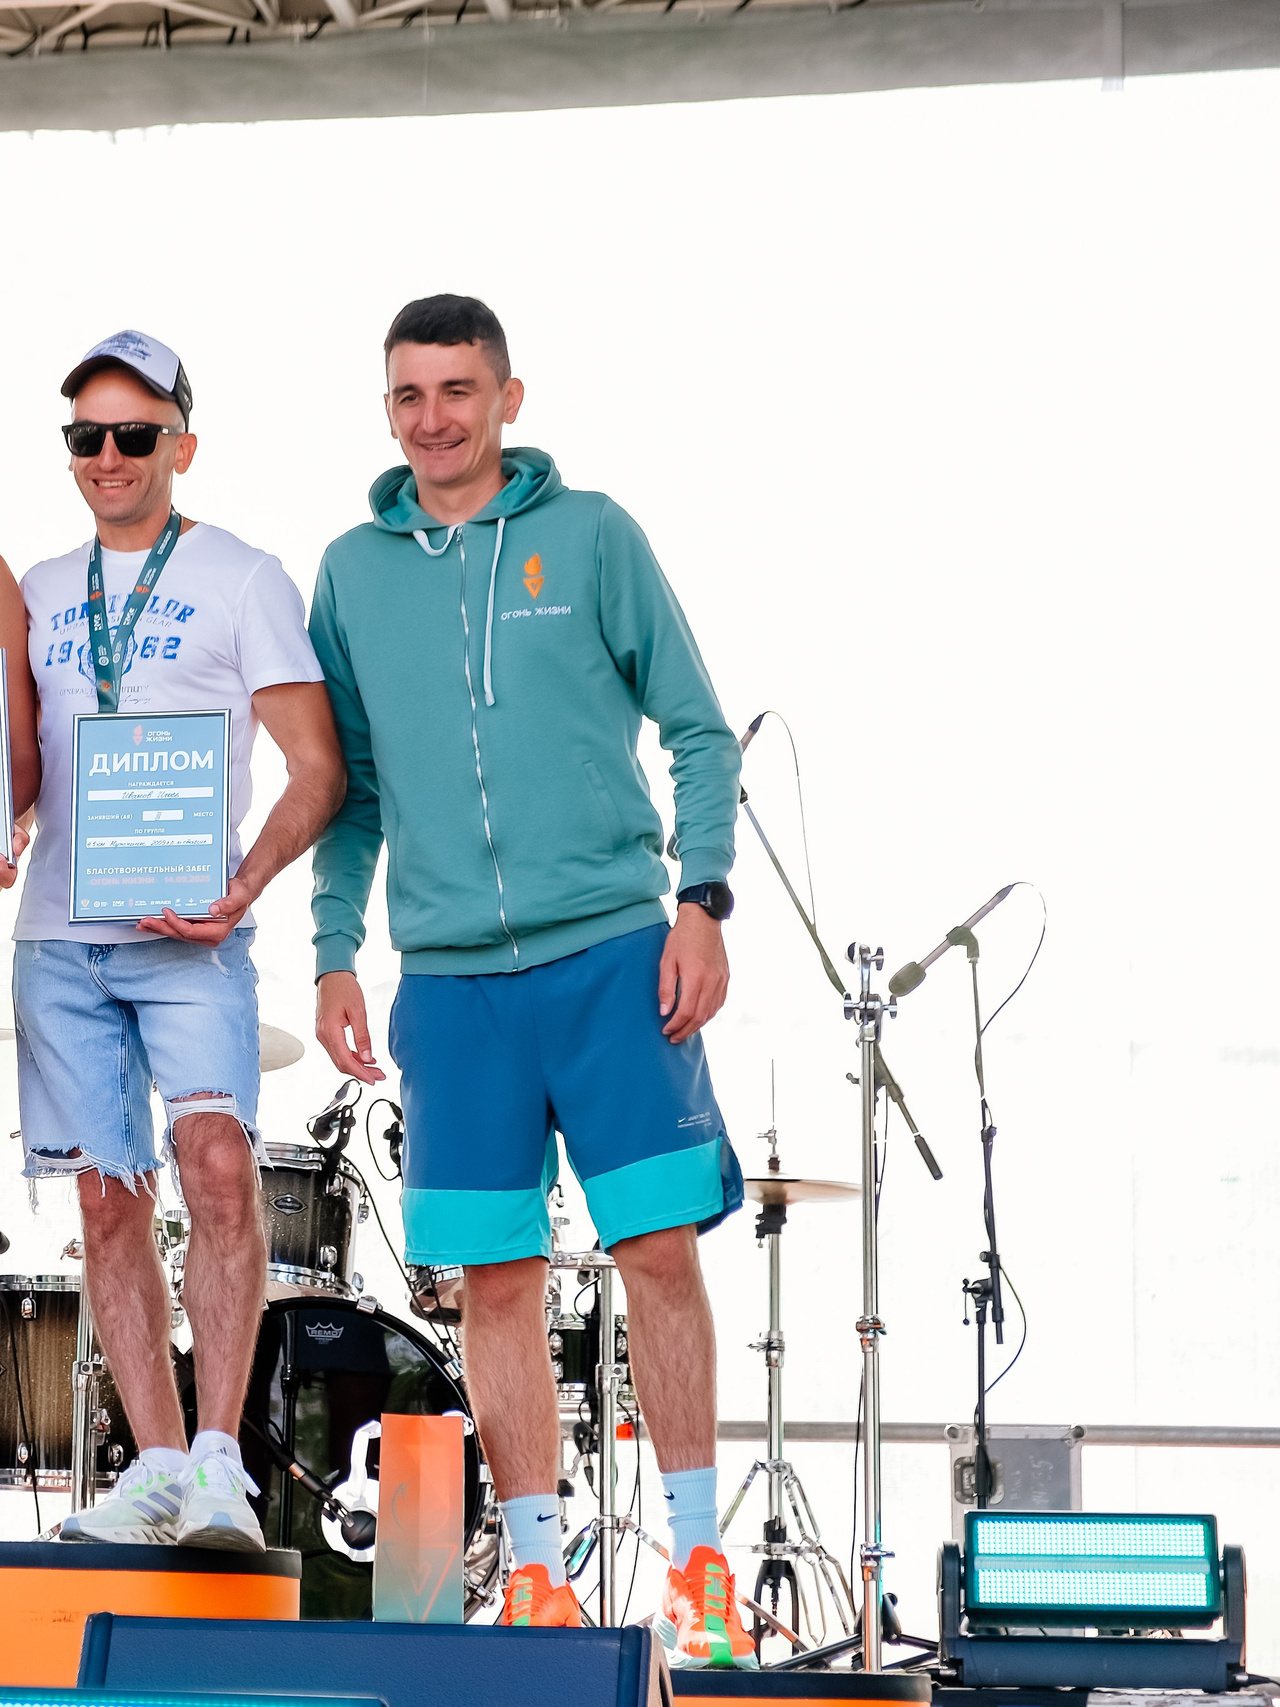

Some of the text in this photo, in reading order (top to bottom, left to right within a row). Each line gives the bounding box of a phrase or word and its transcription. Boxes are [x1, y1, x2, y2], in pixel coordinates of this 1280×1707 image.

[88, 750, 214, 776] ДИПЛОМ
[86, 864, 211, 875] БЛАГОТВОРИТЕЛЬНЫЙ ЗАБЕГ
